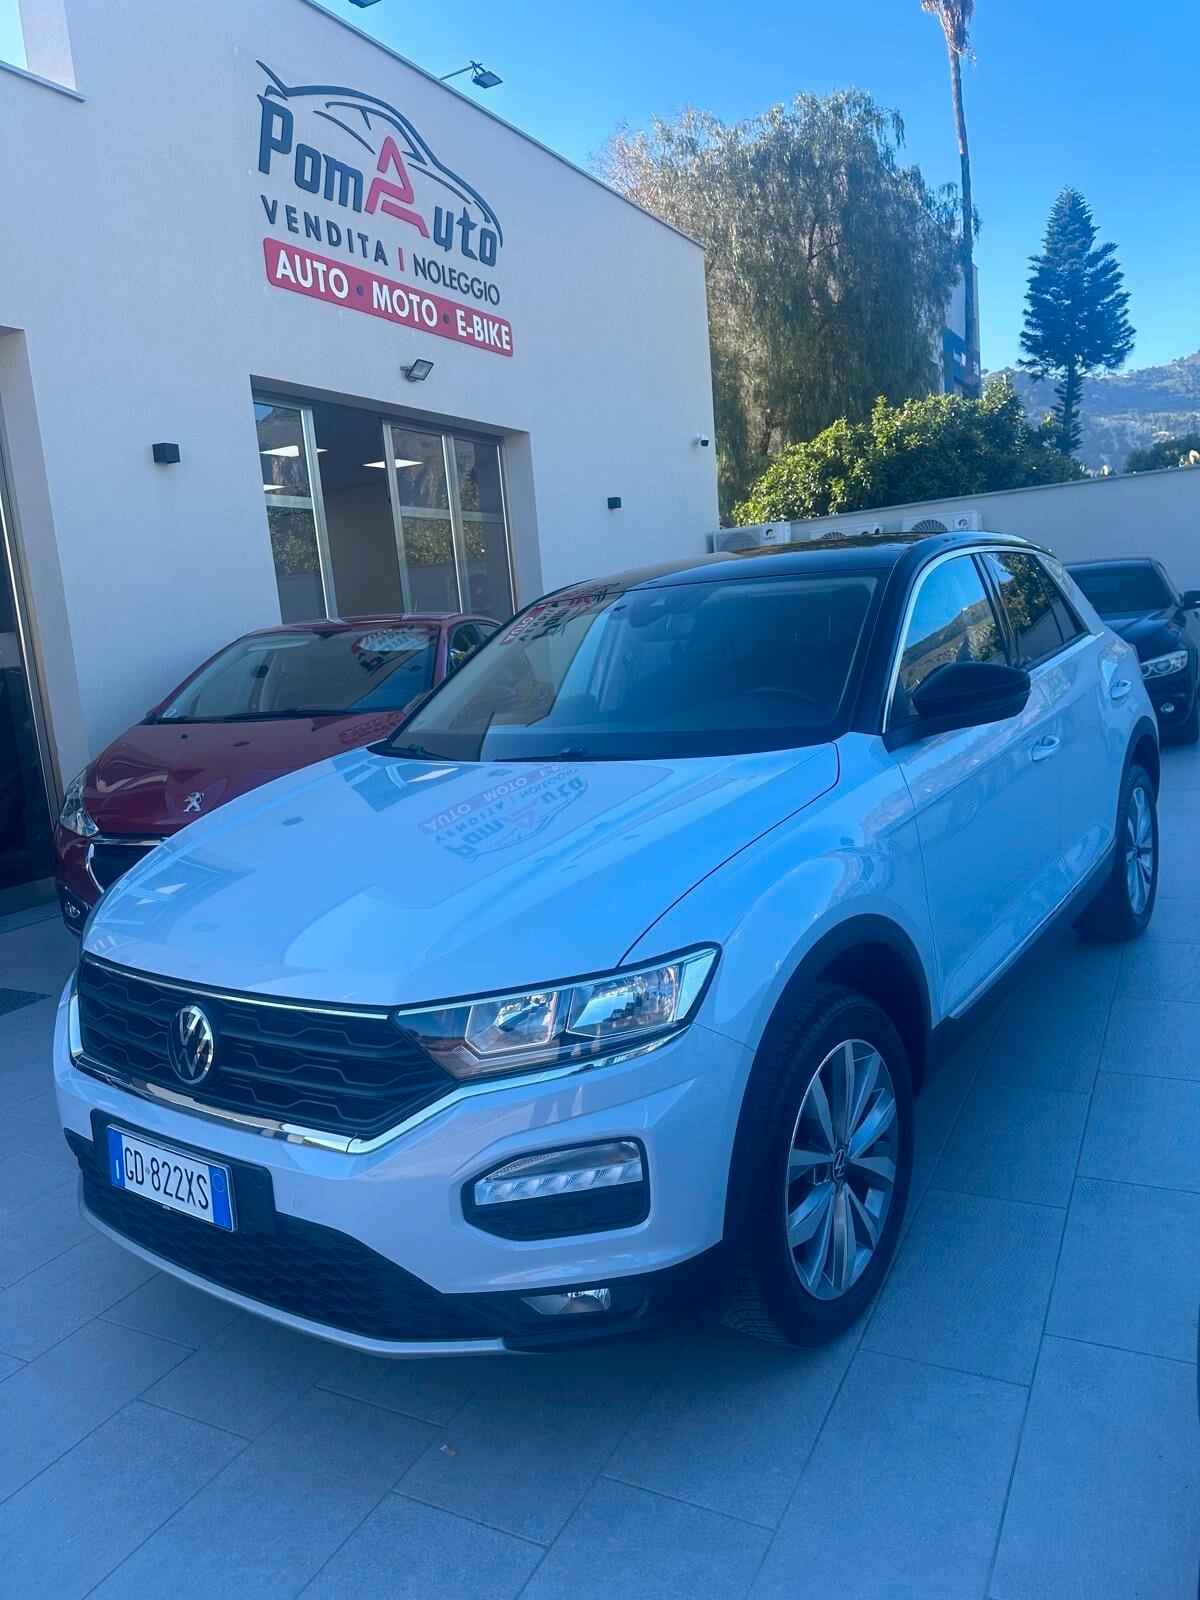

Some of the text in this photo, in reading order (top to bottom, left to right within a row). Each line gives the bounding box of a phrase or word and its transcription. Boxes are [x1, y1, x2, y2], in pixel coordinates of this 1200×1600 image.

[260, 194, 501, 306] VENDITA NOLEGGIO
[275, 249, 511, 351] AUTO MOTO E-BIKE
